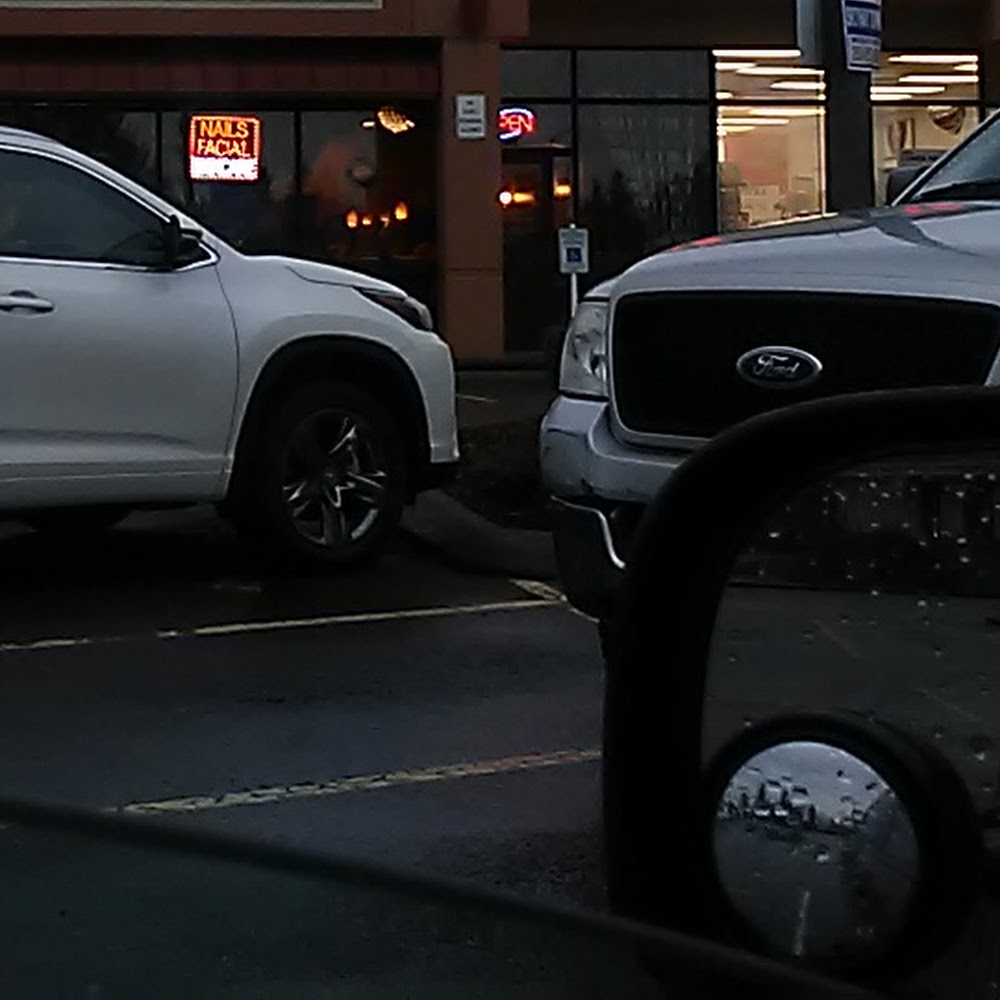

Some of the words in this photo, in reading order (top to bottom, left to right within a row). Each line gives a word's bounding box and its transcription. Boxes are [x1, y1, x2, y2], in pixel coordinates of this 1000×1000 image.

[200, 119, 249, 138] NAILS
[197, 138, 251, 157] FACIAL
[752, 353, 800, 378] Ford
